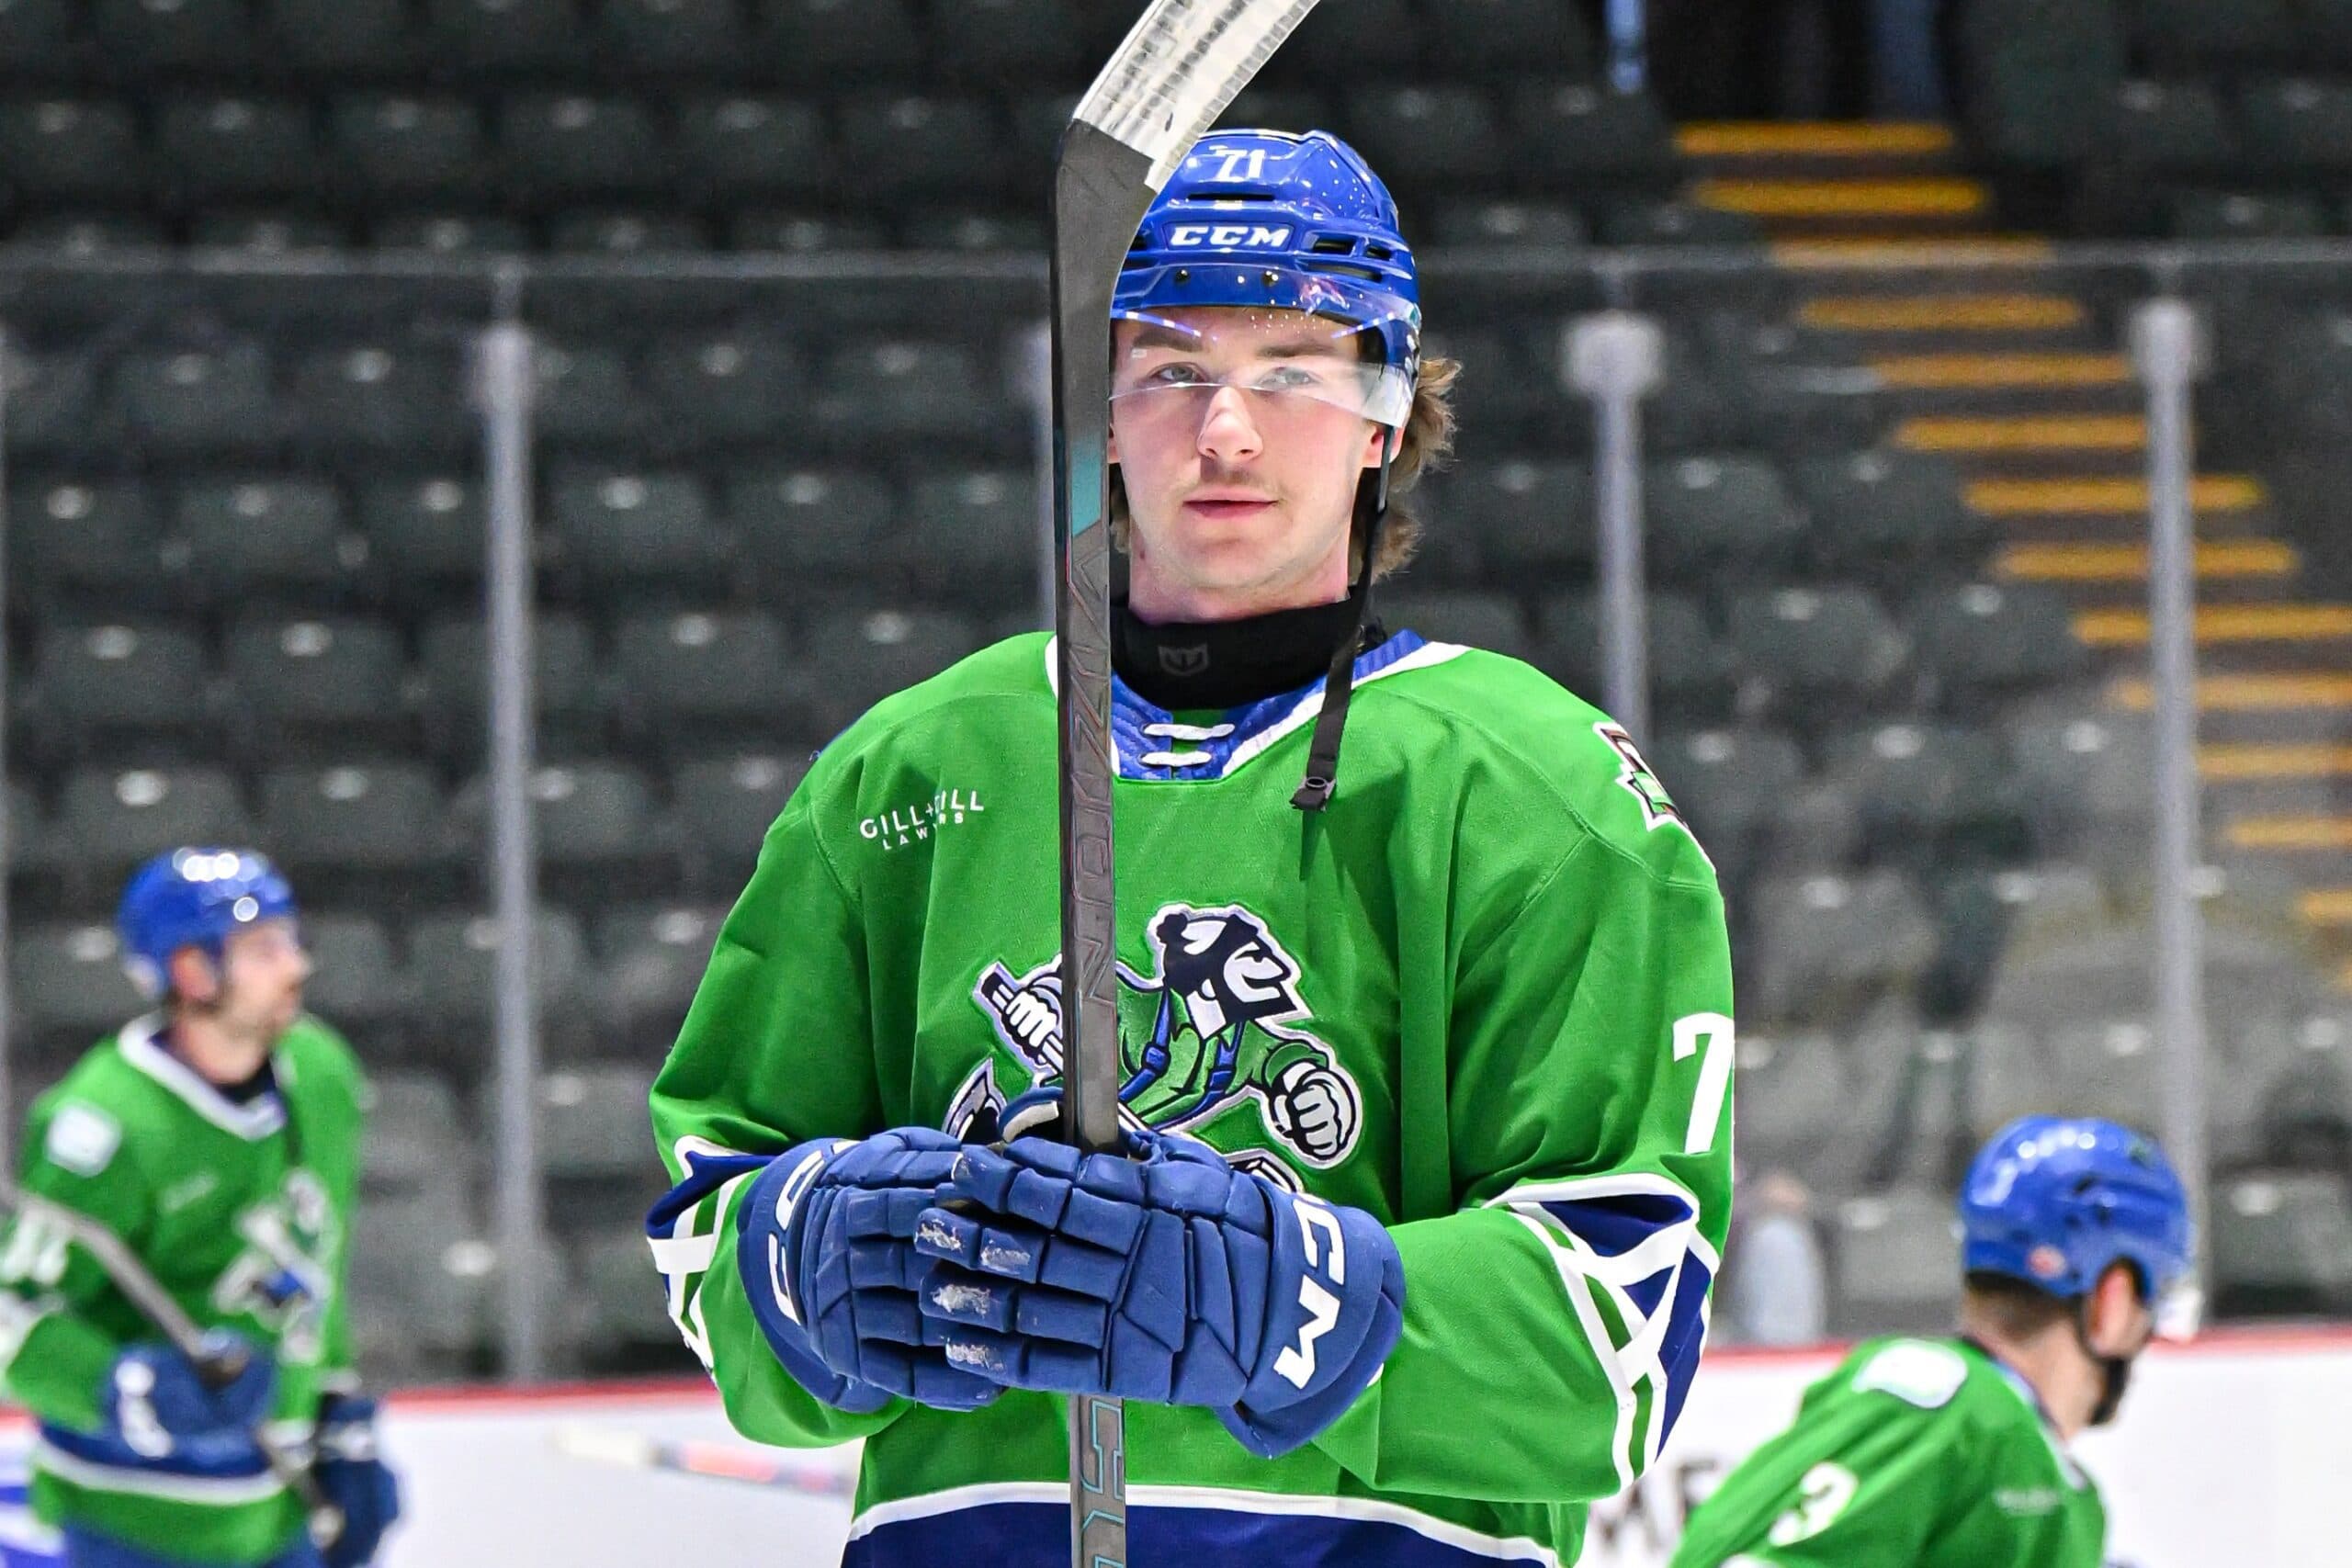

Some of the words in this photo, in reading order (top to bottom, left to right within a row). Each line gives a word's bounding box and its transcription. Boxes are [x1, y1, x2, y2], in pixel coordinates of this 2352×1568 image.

[1214, 149, 1266, 181] 71
[1170, 226, 1290, 247] CCM
[1672, 1012, 1735, 1156] 7
[1272, 1194, 1345, 1390] CM
